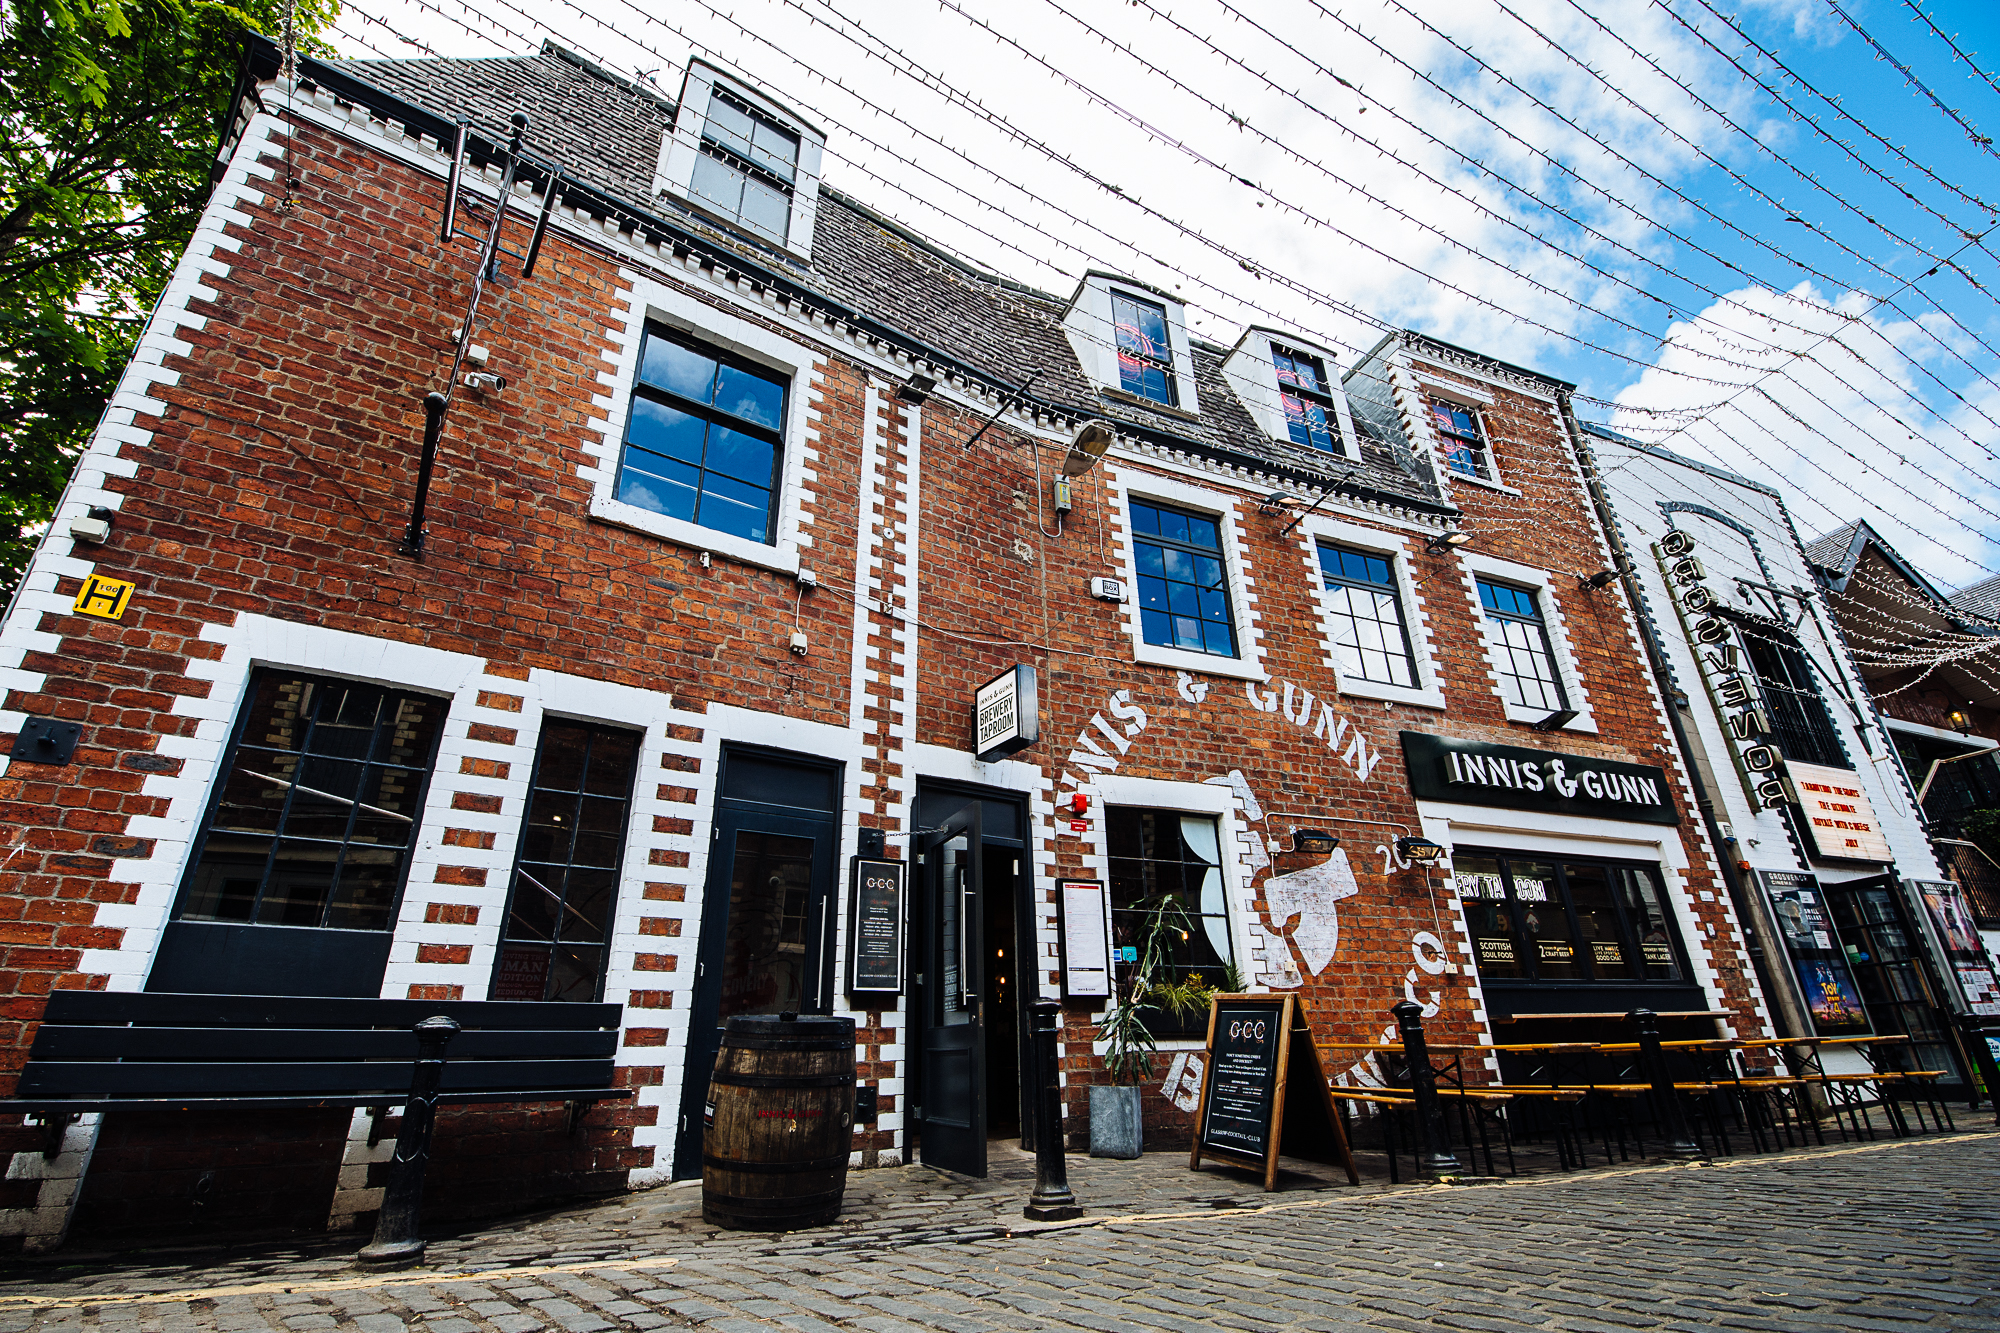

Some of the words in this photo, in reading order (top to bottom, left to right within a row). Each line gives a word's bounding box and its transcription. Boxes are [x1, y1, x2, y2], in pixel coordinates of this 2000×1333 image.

[979, 693, 993, 707] INNIS
[993, 689, 999, 698] &
[998, 681, 1014, 695] GUNN
[980, 696, 1014, 726] BREWERY
[980, 711, 1014, 741] TAPROOM
[1246, 673, 1382, 783] GUNN
[1444, 751, 1544, 792] INNIS
[1545, 758, 1579, 798] &
[1576, 770, 1662, 806] GUNN
[1480, 942, 1512, 951] SCOTTISH
[1834, 1002, 1842, 1015] 4
[758, 1109, 785, 1118] INNIS
[788, 1108, 797, 1119] &
